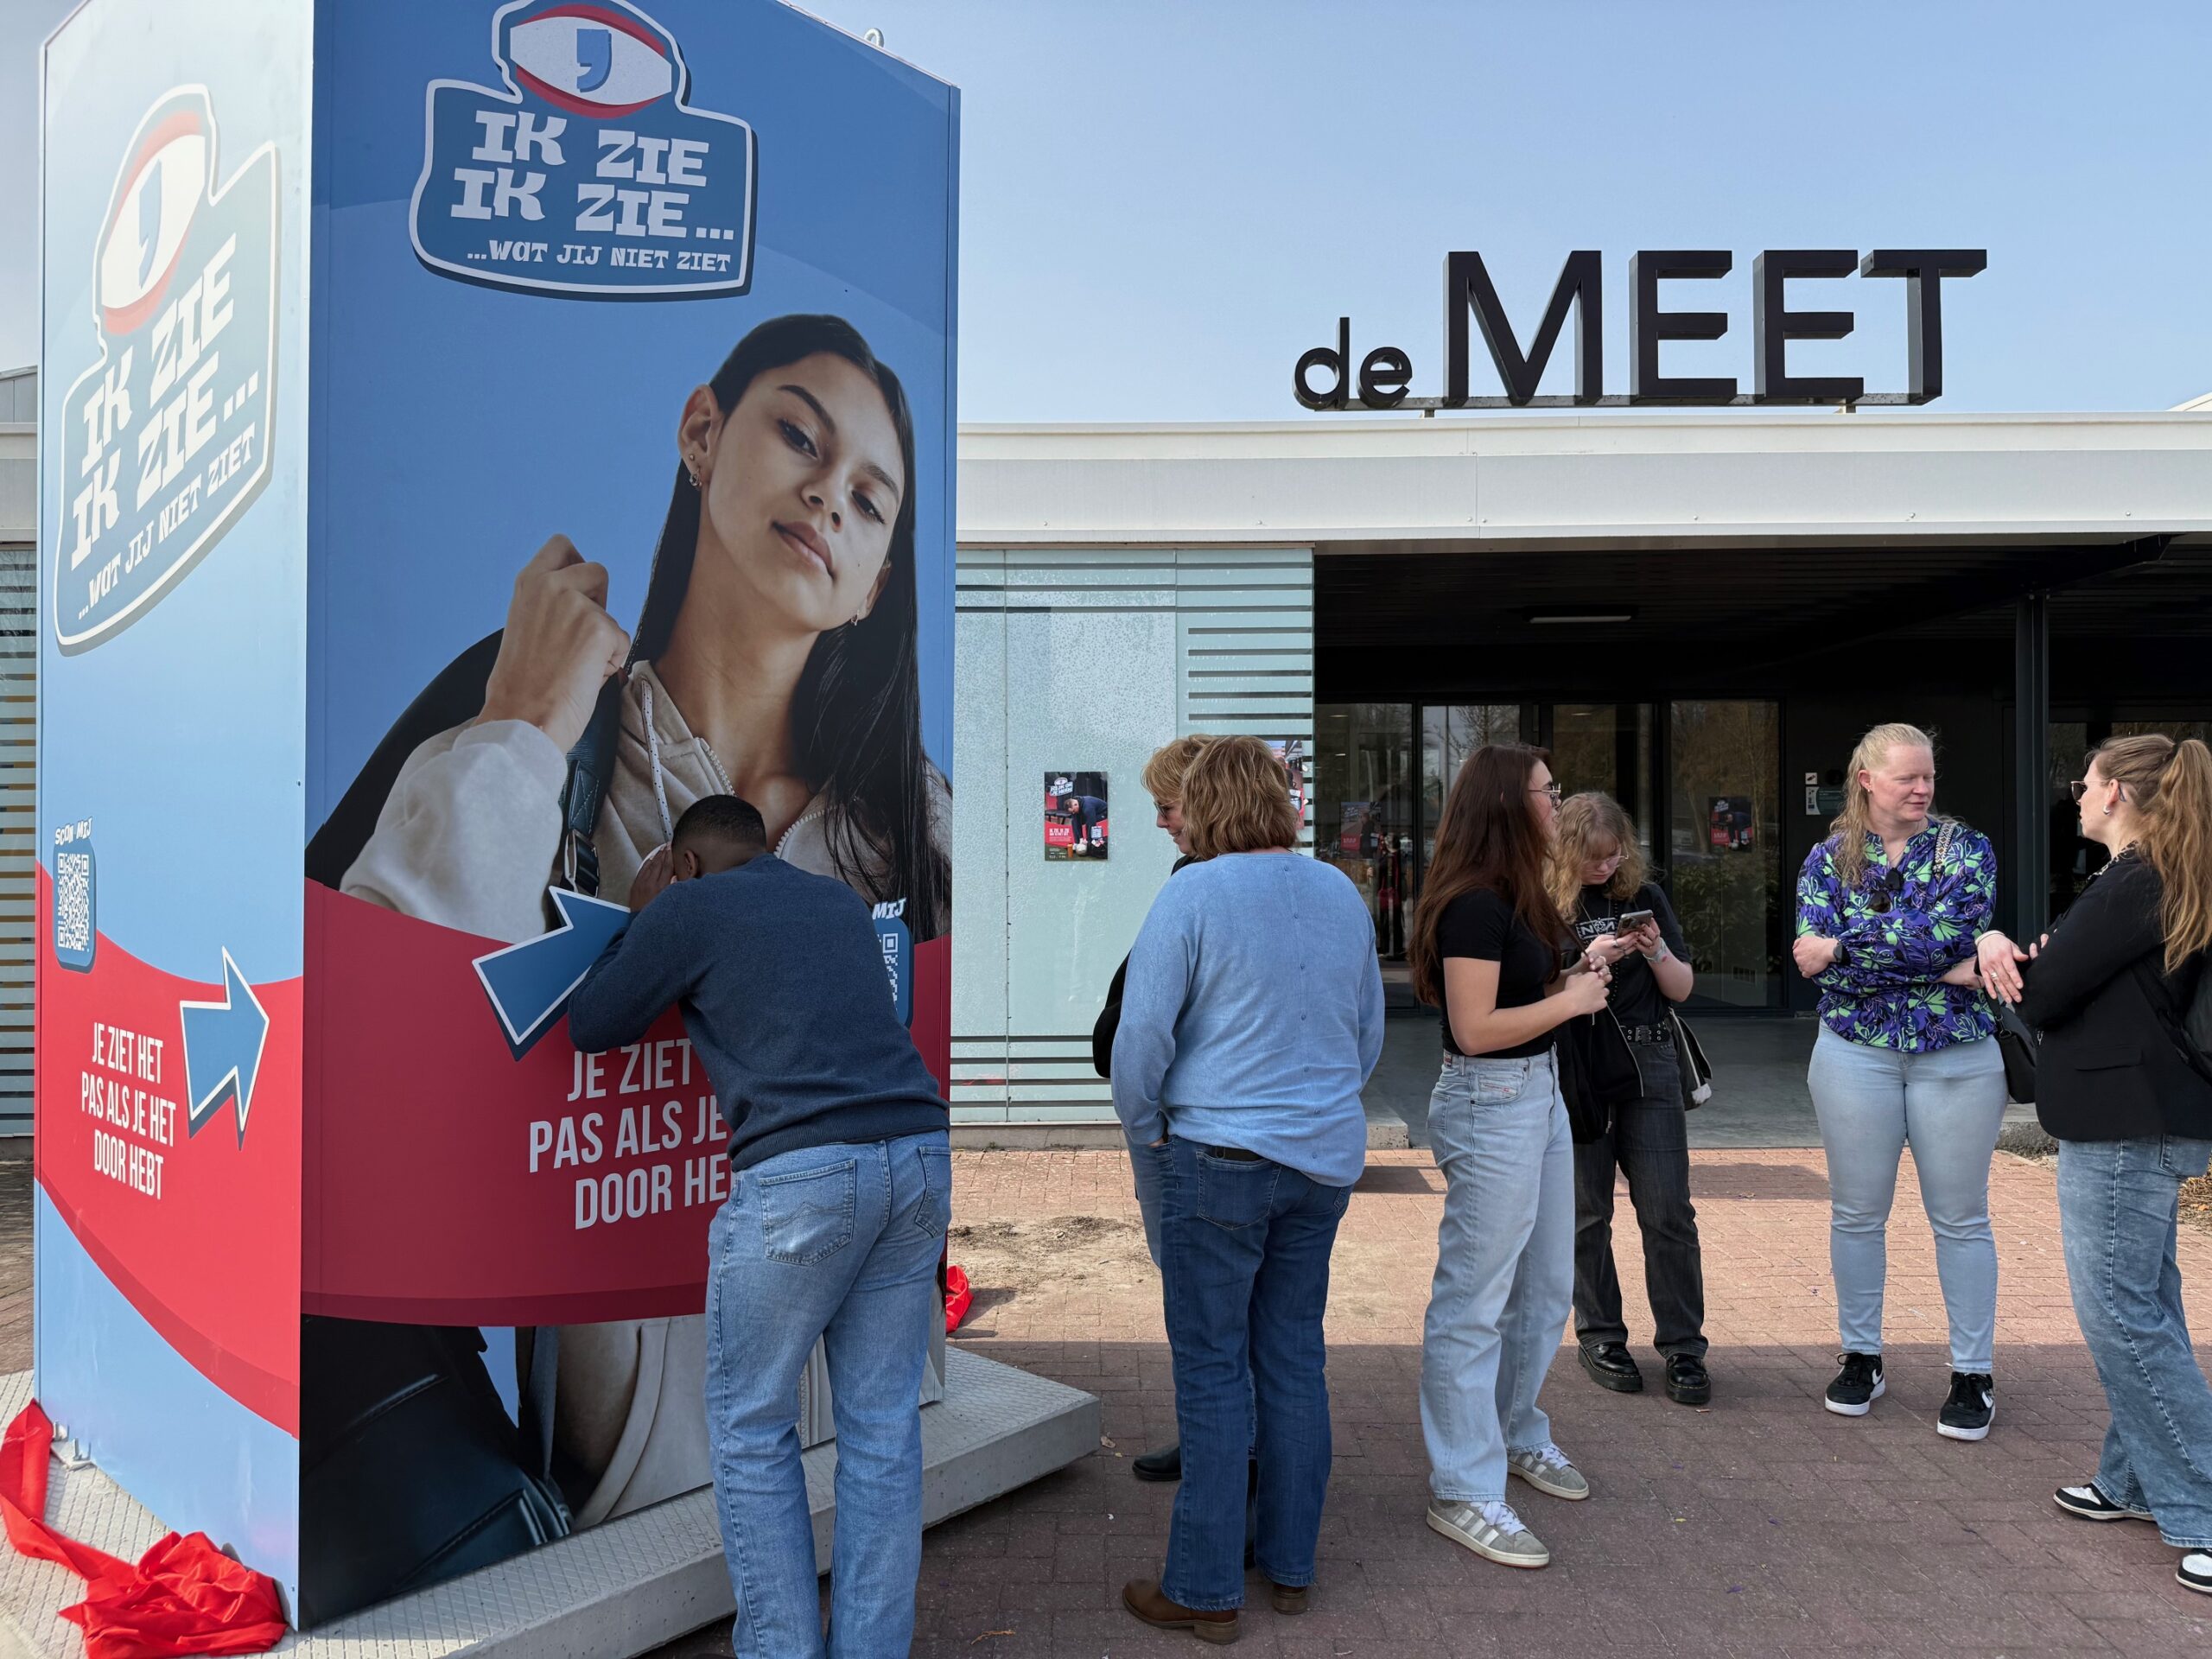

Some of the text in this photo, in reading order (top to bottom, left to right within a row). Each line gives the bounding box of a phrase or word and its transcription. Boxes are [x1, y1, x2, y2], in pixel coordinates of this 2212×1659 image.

[472, 110, 709, 187] IK ZIE
[450, 168, 734, 240] IK ZIE...
[556, 245, 602, 265] JIJ
[610, 247, 669, 269] NIET
[677, 251, 731, 272] ZIET
[82, 232, 237, 478] IK ZIE
[1292, 249, 1987, 409] de MEET
[71, 351, 258, 571] IK ZIE...
[125, 520, 154, 575] JIJ
[158, 474, 202, 544] NIET
[207, 422, 256, 499] ZIET
[76, 817, 92, 839] MIJ
[872, 898, 906, 919] MIJ
[92, 1022, 163, 1084] JE ZIET HET
[567, 1039, 691, 1101] JE ZIET
[82, 1071, 176, 1147] PAS ALS JE HET
[530, 1095, 728, 1173] PAS ALS JE
[94, 1129, 163, 1200] DOOR HEBT
[575, 1154, 734, 1230] DOOR HE
